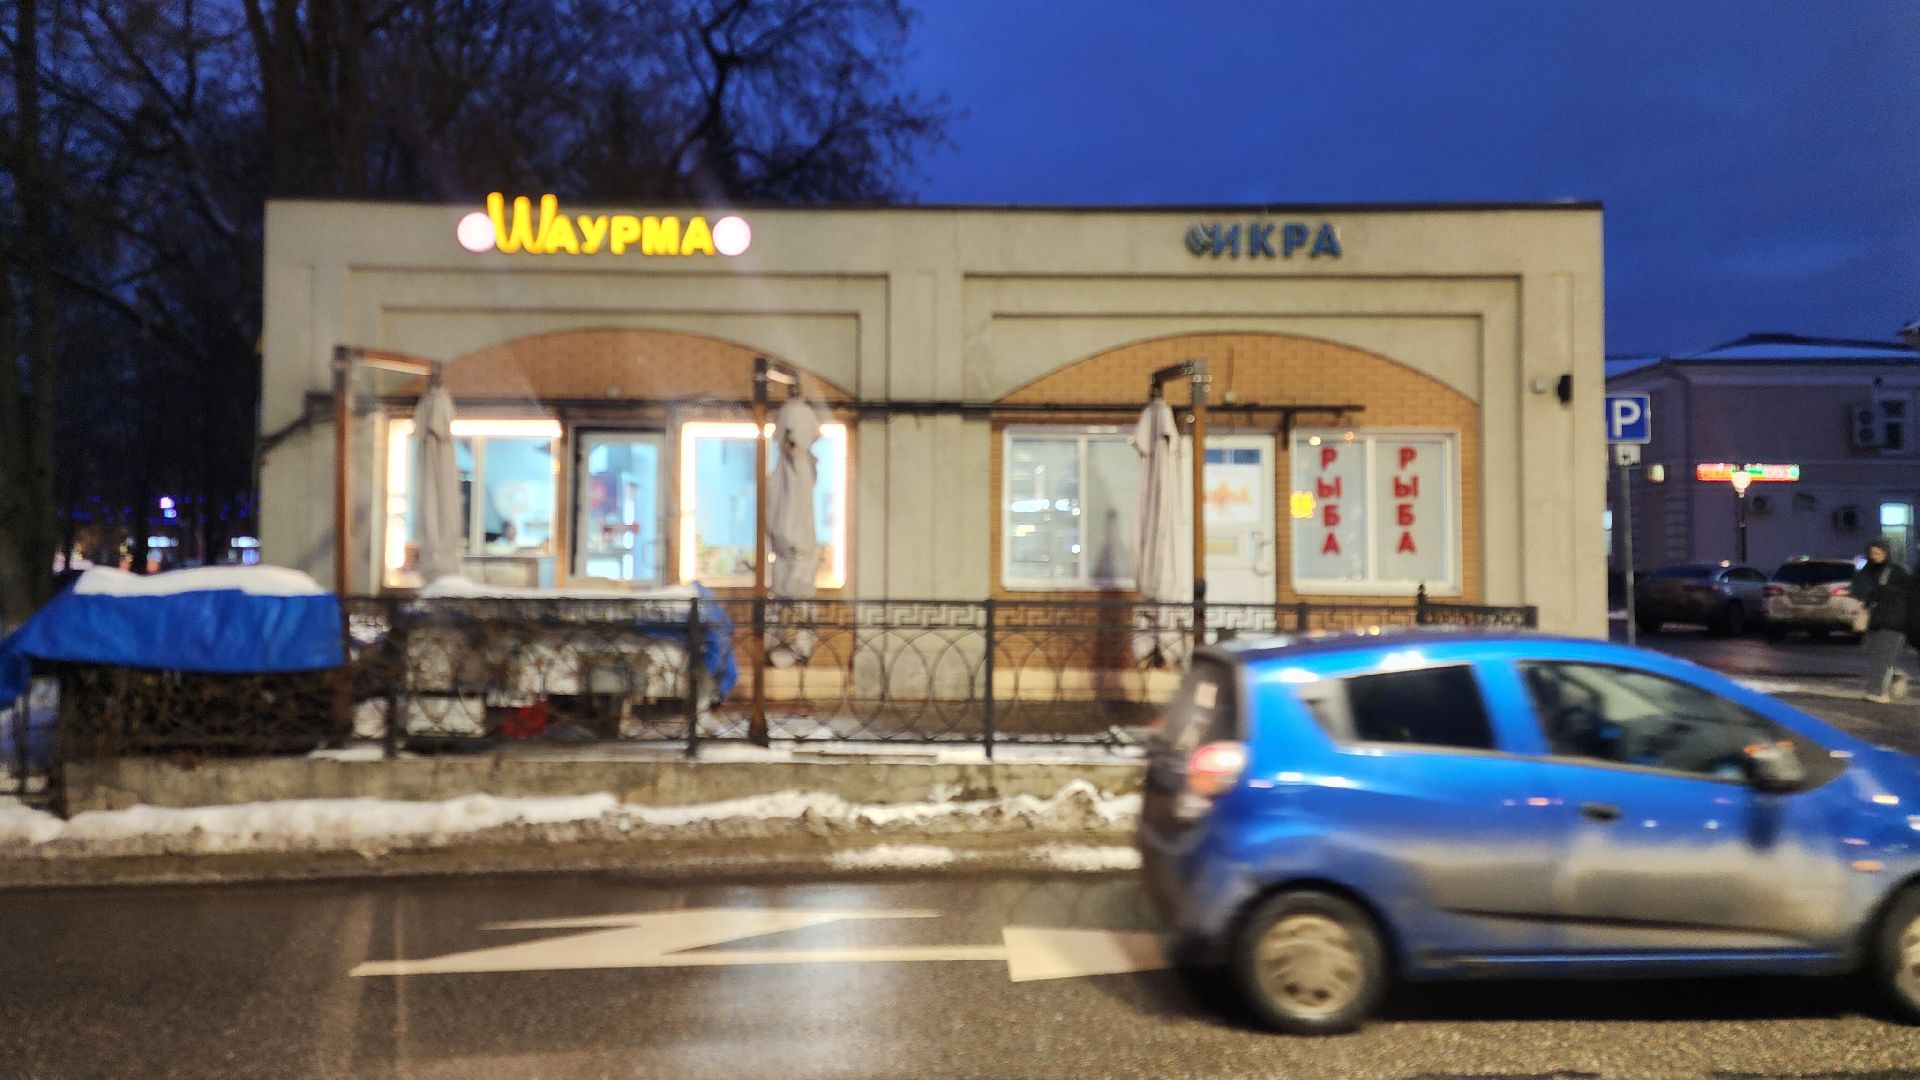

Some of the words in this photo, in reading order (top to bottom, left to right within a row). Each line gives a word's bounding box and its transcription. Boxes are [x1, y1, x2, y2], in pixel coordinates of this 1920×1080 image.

[487, 192, 716, 255] ШАУРМА
[1212, 222, 1343, 258] ИКРА
[1613, 399, 1642, 438] P
[1316, 446, 1342, 555] РЫБА
[1393, 446, 1420, 554] РЫБА
